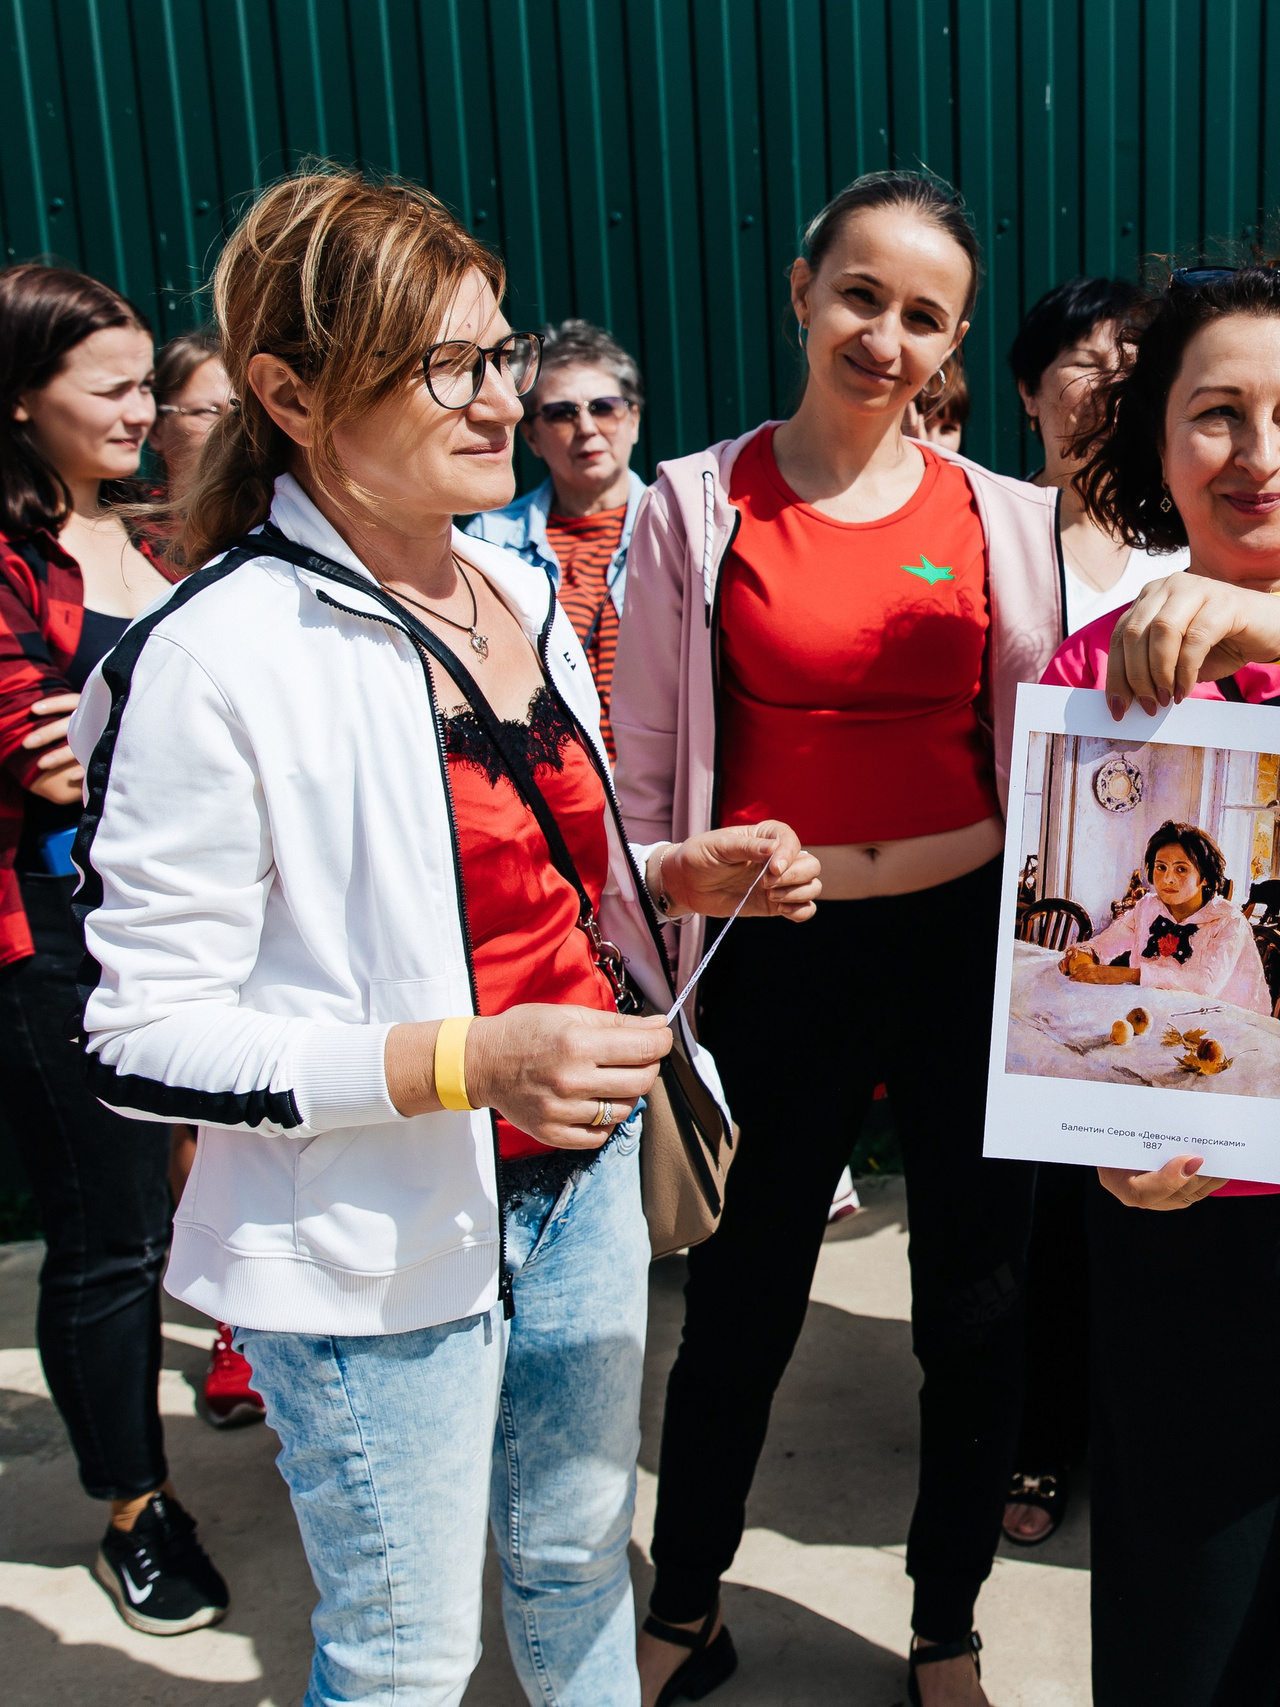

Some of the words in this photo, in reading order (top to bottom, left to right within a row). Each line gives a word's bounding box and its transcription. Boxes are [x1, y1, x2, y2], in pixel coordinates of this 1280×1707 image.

[1061, 1122, 1105, 1134] Валентин
[1107, 1127, 1136, 1137] Серов
[1138, 1131, 1181, 1142] «Девочка
[1191, 1137, 1246, 1147] персиками»
[1143, 1141, 1163, 1150] 1887
